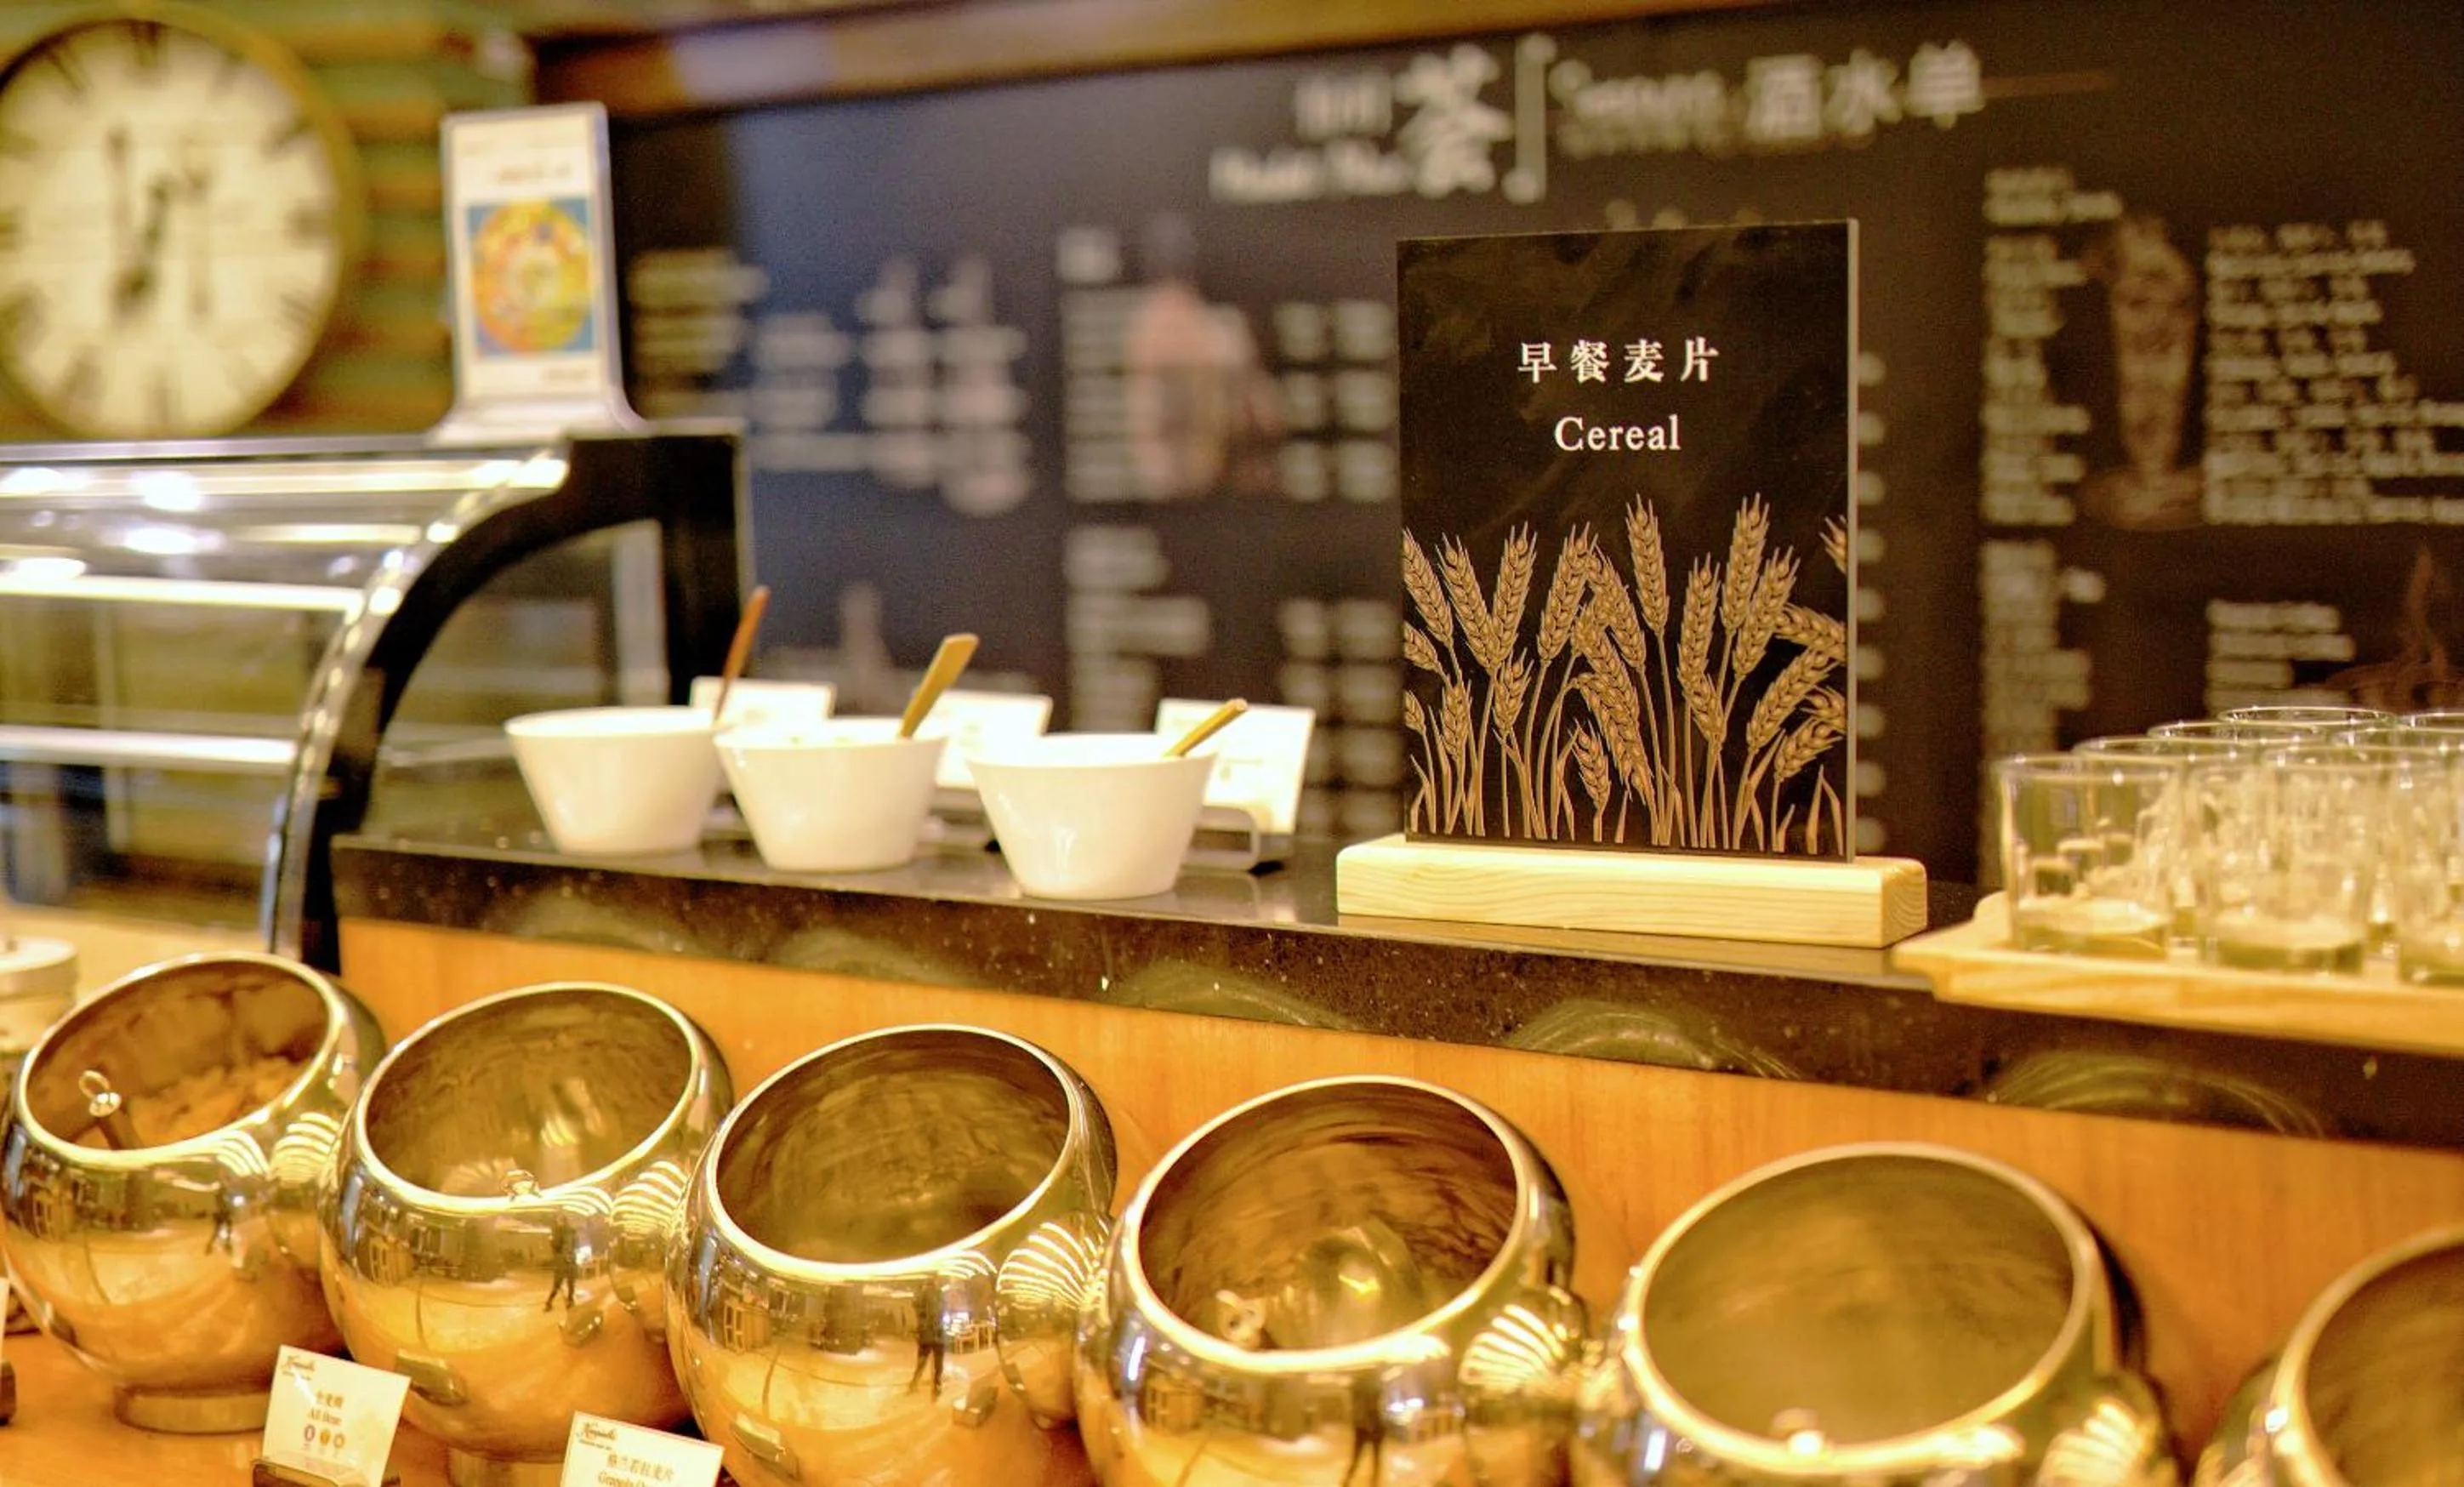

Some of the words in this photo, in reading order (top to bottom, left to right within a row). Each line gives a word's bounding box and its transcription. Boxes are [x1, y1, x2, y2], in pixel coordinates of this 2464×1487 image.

[1517, 337, 1720, 384] 早餐麦片
[1554, 413, 1681, 451] Cereal
